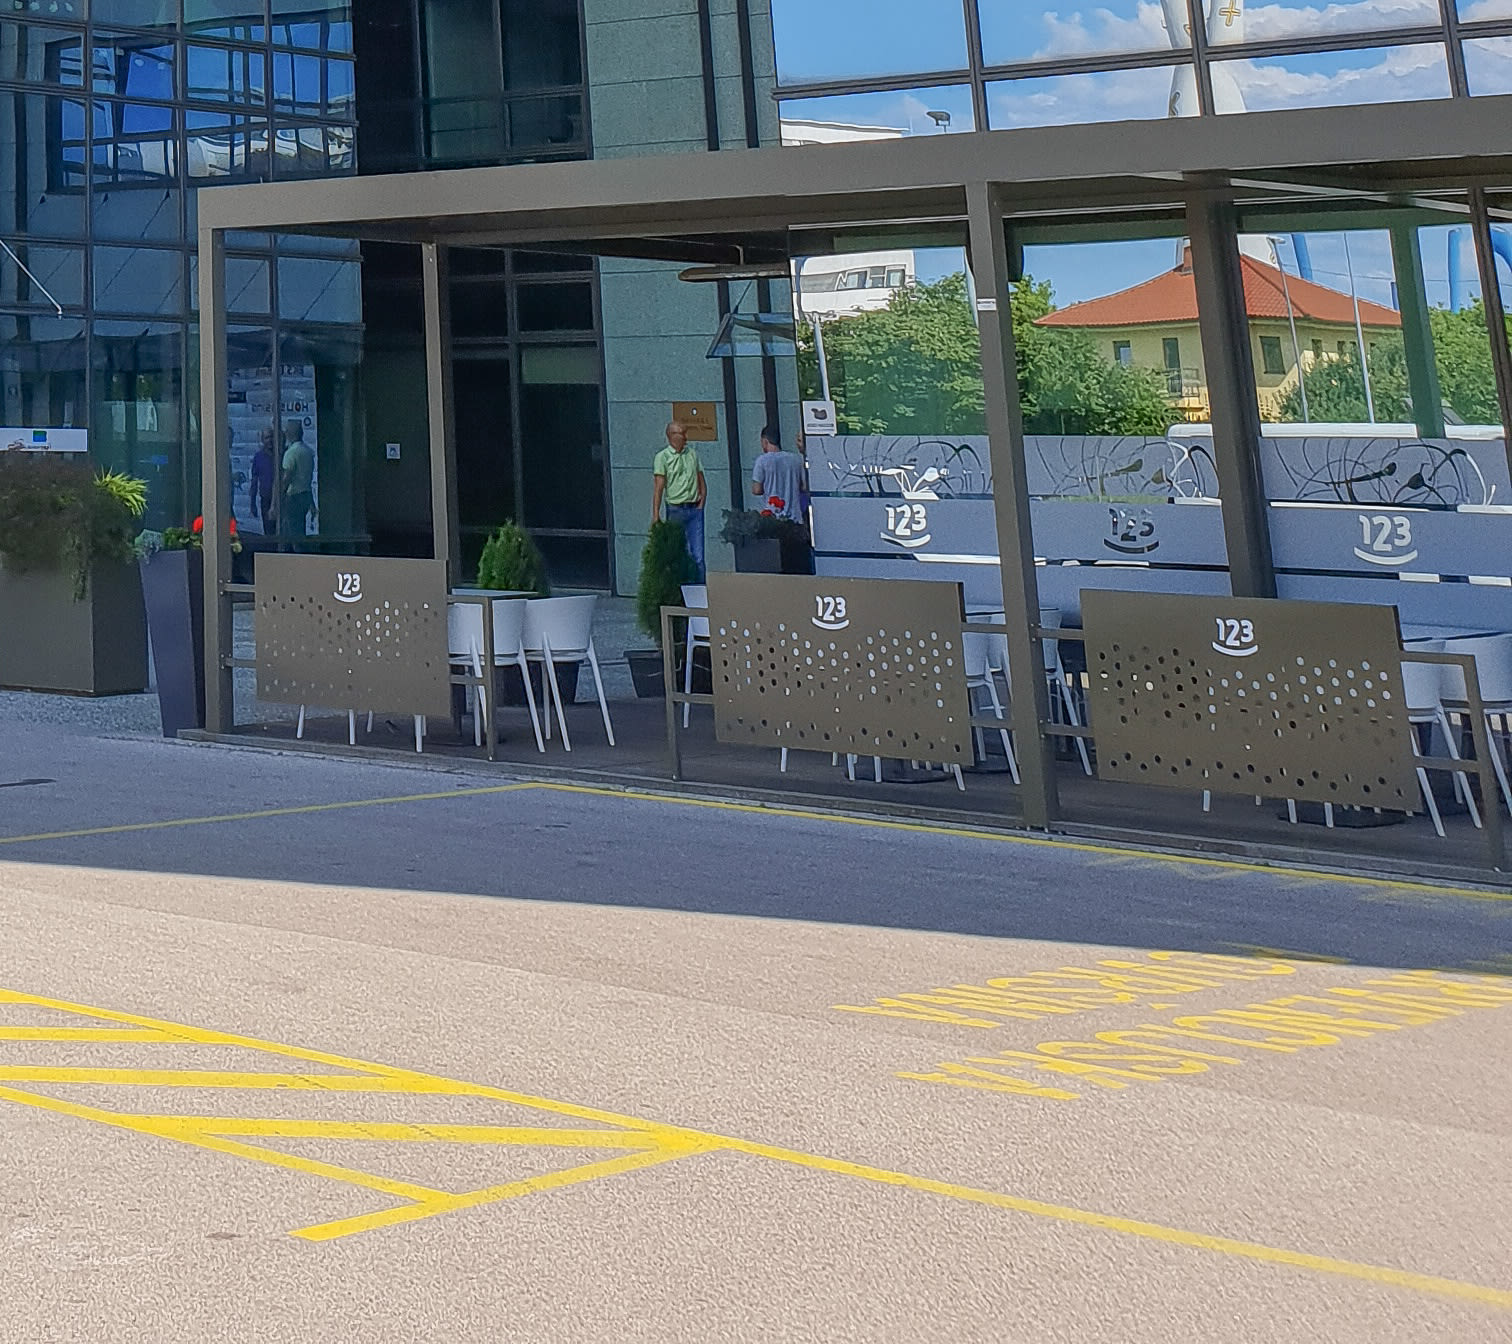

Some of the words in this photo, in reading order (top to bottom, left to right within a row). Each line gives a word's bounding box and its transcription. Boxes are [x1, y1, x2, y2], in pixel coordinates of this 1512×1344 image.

[885, 503, 927, 536] 123
[1358, 515, 1412, 552] 123
[337, 572, 361, 595] 123
[815, 595, 847, 622] 123
[1215, 617, 1255, 647] 123
